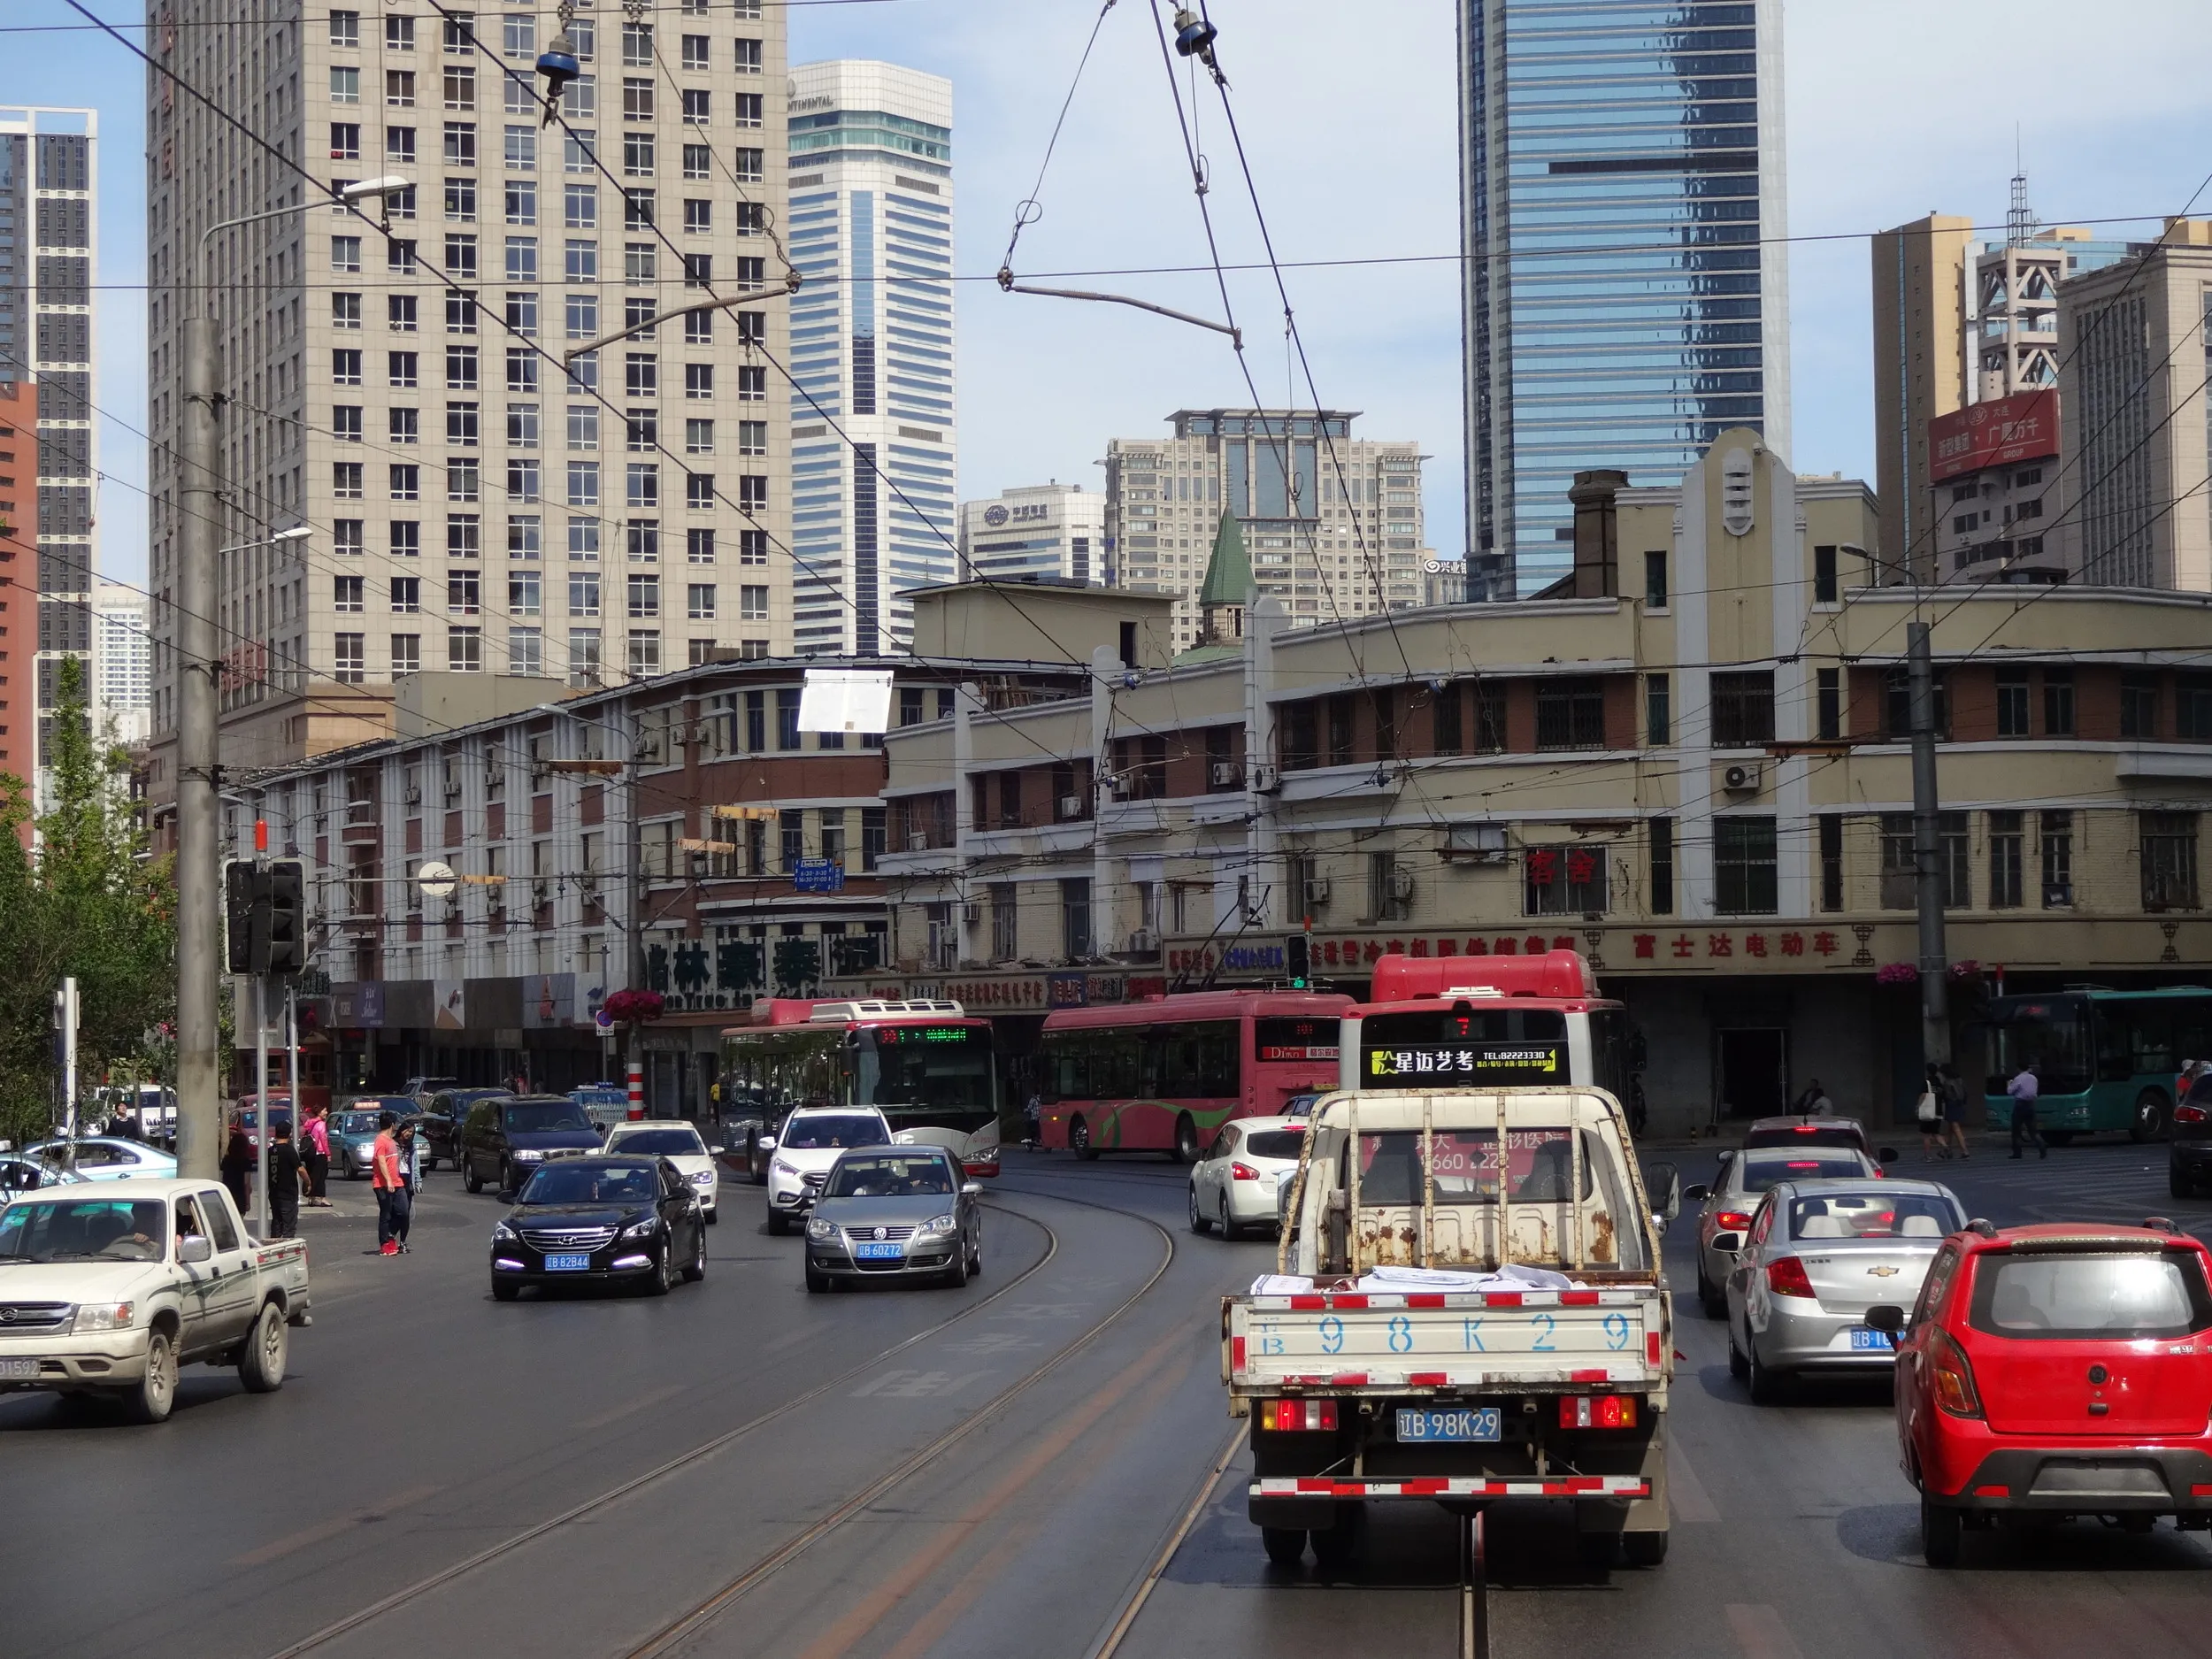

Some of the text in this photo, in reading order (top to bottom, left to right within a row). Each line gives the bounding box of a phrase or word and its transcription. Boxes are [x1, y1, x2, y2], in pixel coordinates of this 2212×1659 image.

[1633, 933, 1839, 959] 富士达电动车
[1396, 1050, 1474, 1072] 星迈艺考
[1483, 1051, 1545, 1061] TEL:82223330
